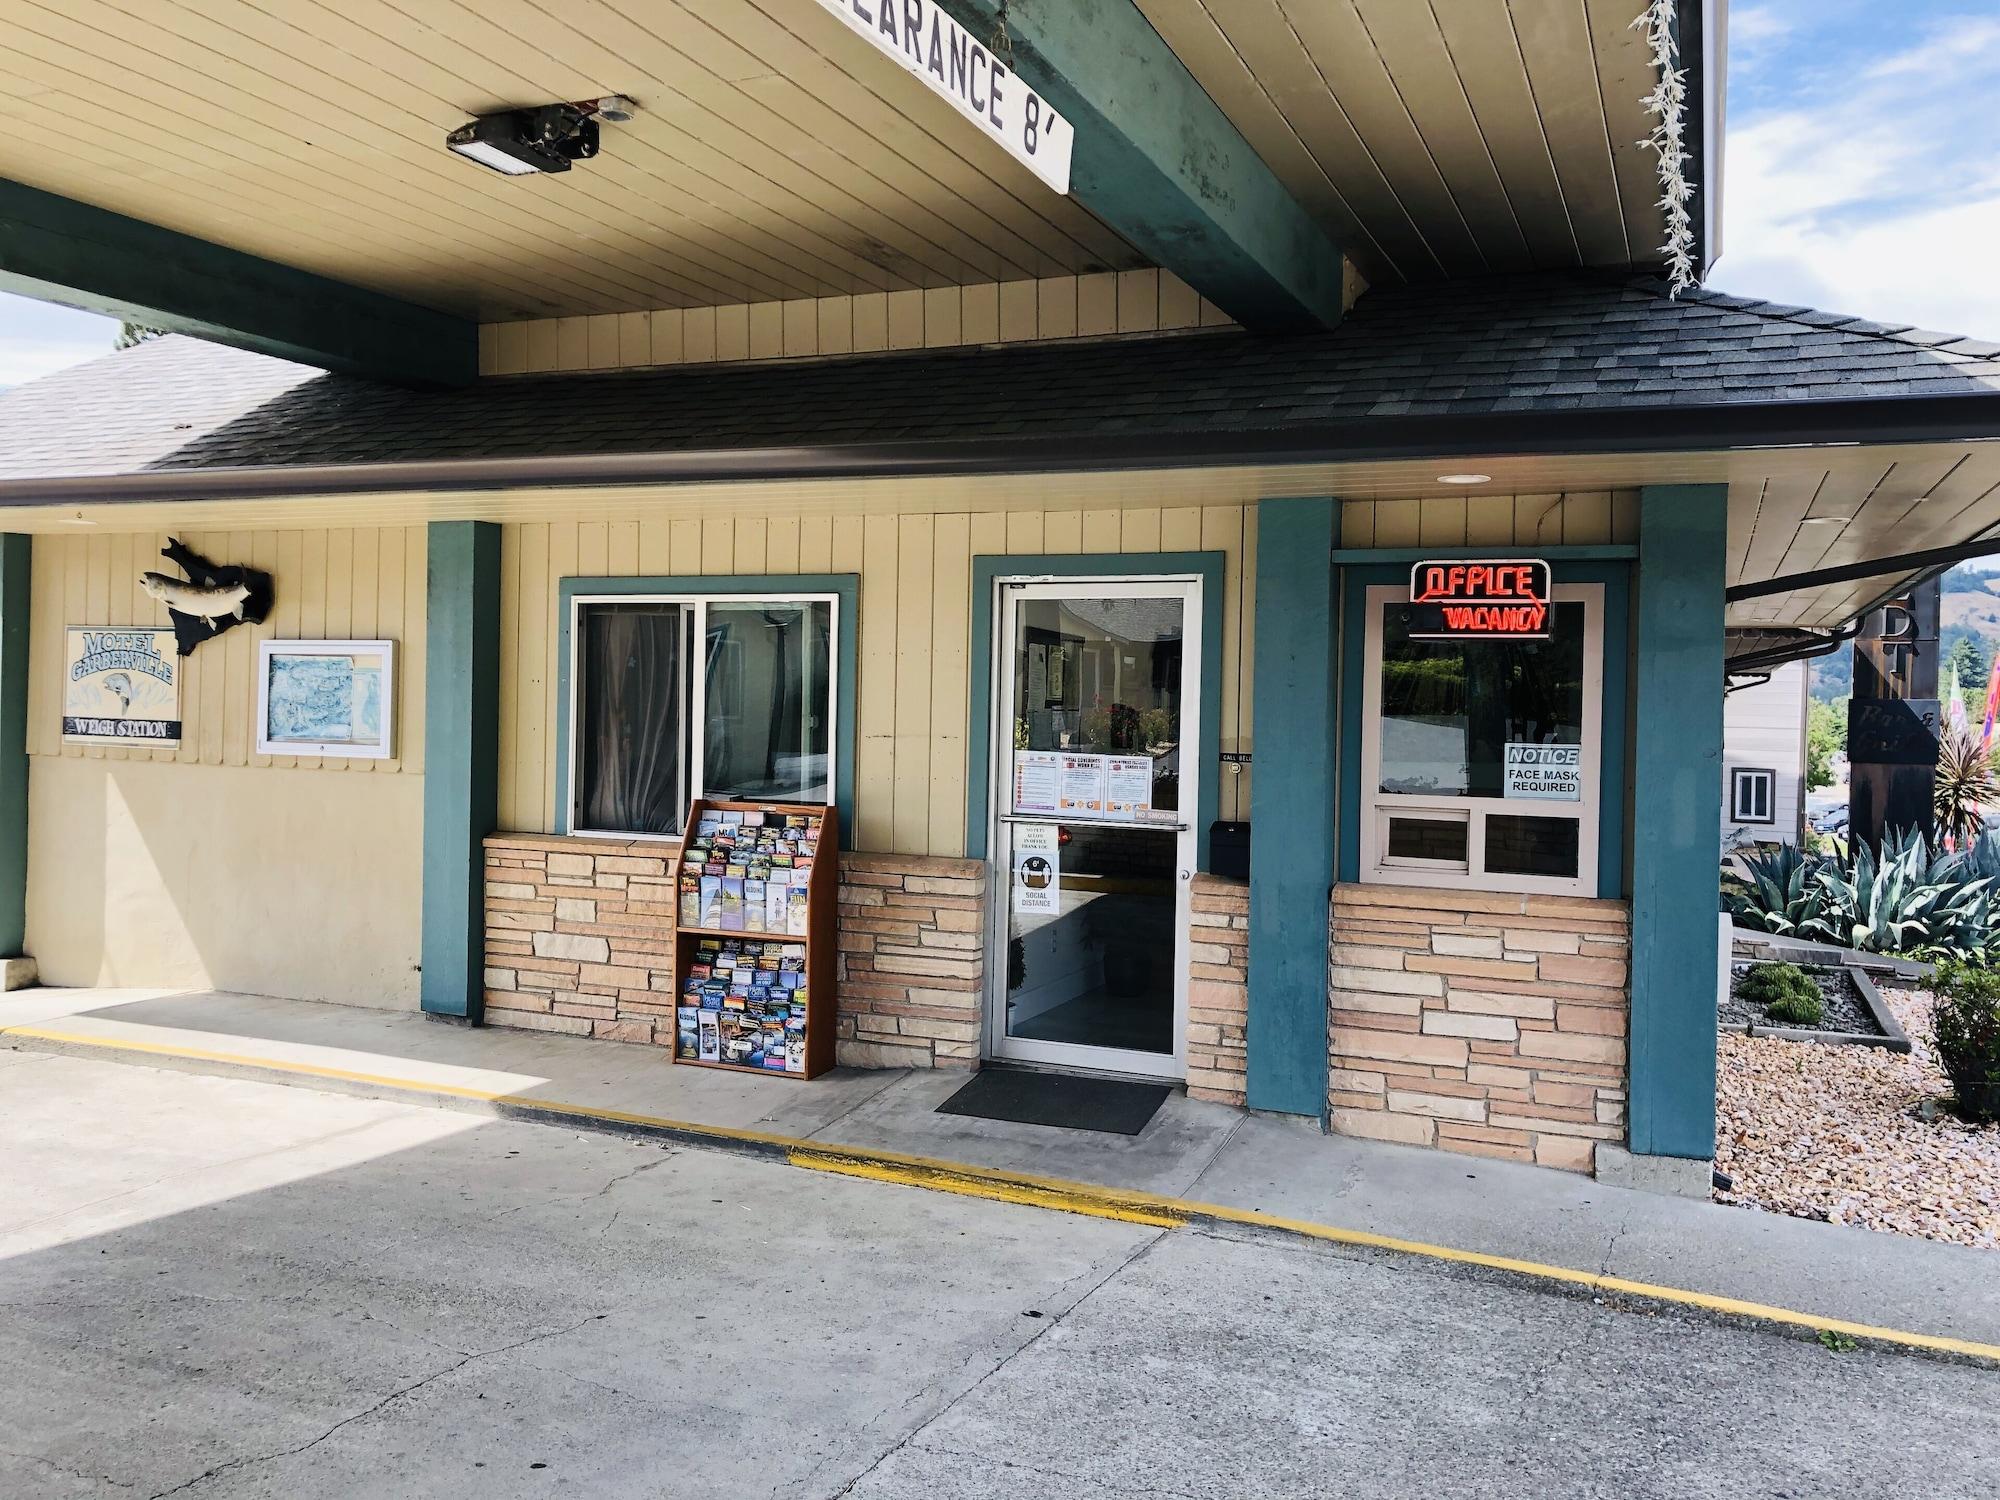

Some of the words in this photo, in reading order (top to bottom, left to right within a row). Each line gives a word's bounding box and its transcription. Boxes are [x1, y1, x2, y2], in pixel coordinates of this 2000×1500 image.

[839, 0, 1006, 131] ARANCE
[1023, 92, 1056, 156] 8'
[1425, 566, 1534, 596] OFFICE
[1442, 606, 1547, 632] VACANCY
[82, 632, 161, 660] MOTEL
[71, 650, 173, 686] GARBERVILLE
[75, 717, 116, 735] WEIGH
[117, 720, 168, 738] STATION
[1508, 747, 1581, 764] NOTICE
[1508, 769, 1541, 780] FACE
[1543, 770, 1580, 781] MASK
[1512, 781, 1576, 793] REQUIRED
[1136, 811, 1145, 820] NO
[1147, 812, 1178, 822] SMOKING
[1021, 899, 1051, 907] DISTANCE
[1025, 891, 1048, 899] SOCIAL
